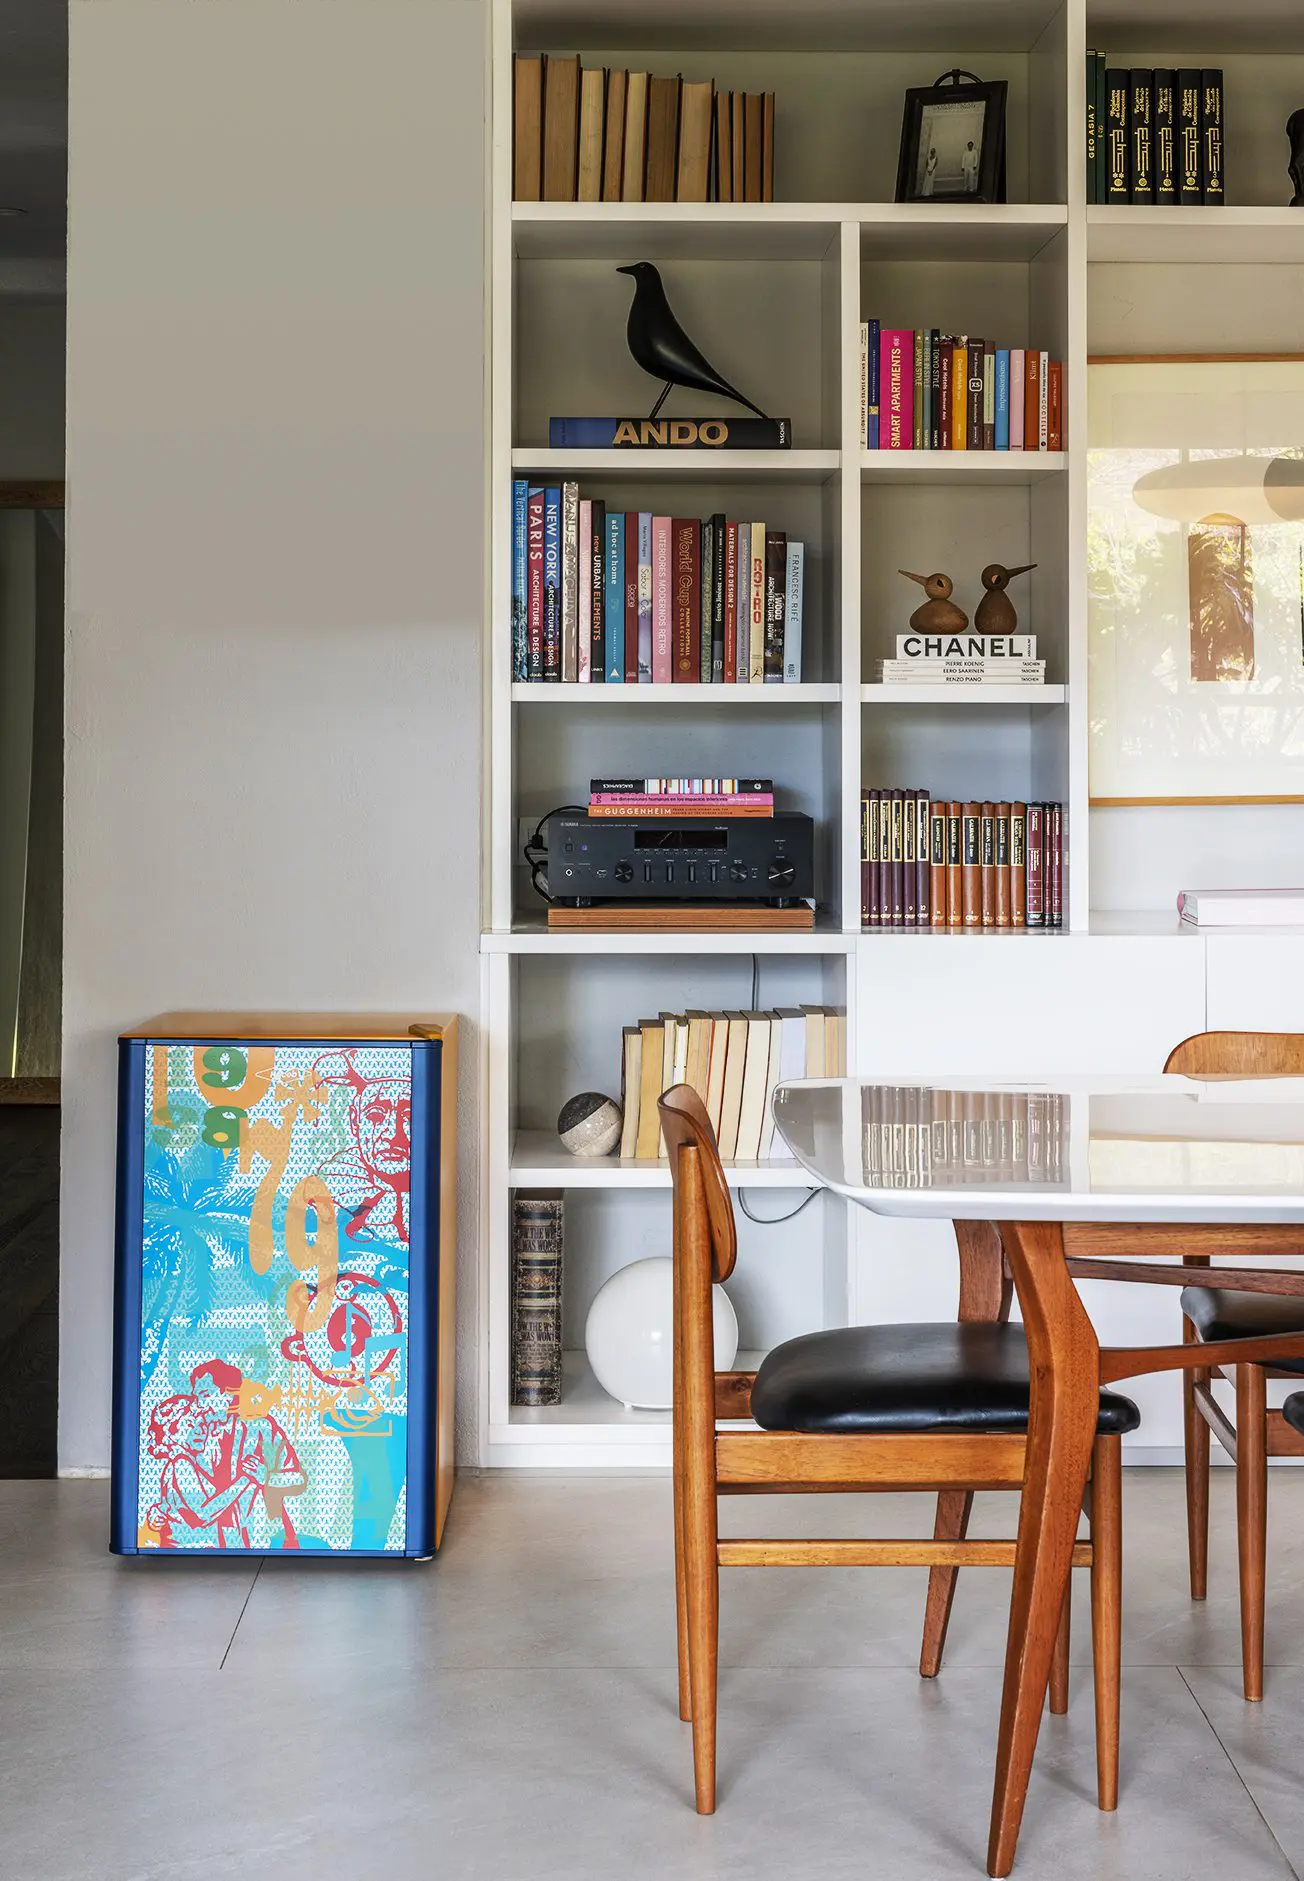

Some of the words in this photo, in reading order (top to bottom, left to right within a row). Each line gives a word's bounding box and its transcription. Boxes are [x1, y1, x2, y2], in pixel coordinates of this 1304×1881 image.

[891, 348, 901, 412] APARTMENTS
[923, 370, 931, 389] STYLE
[612, 421, 729, 446] ANDO
[891, 414, 901, 448] SMART
[531, 504, 542, 560] PARIS
[546, 504, 557, 536] NEW
[612, 519, 618, 530] ad
[546, 543, 557, 578] YORK
[612, 550, 618, 559] at
[658, 530, 667, 577] INTERIORES
[679, 527, 692, 572] World
[594, 555, 603, 589] URBAN
[640, 568, 650, 590] Sabor
[791, 554, 799, 600] FRANCESC
[532, 569, 540, 626] ARCHITECTURE
[658, 580, 667, 626] MODERNOS
[677, 575, 692, 607] Cup
[594, 591, 603, 641] ELEMENTS
[640, 599, 651, 619] Color
[532, 637, 540, 667] DESIGN
[548, 642, 556, 667] DESIGN
[658, 629, 667, 655] RETRO
[903, 637, 1023, 657] CHANEL
[604, 807, 672, 815] GUGGENHEIM
